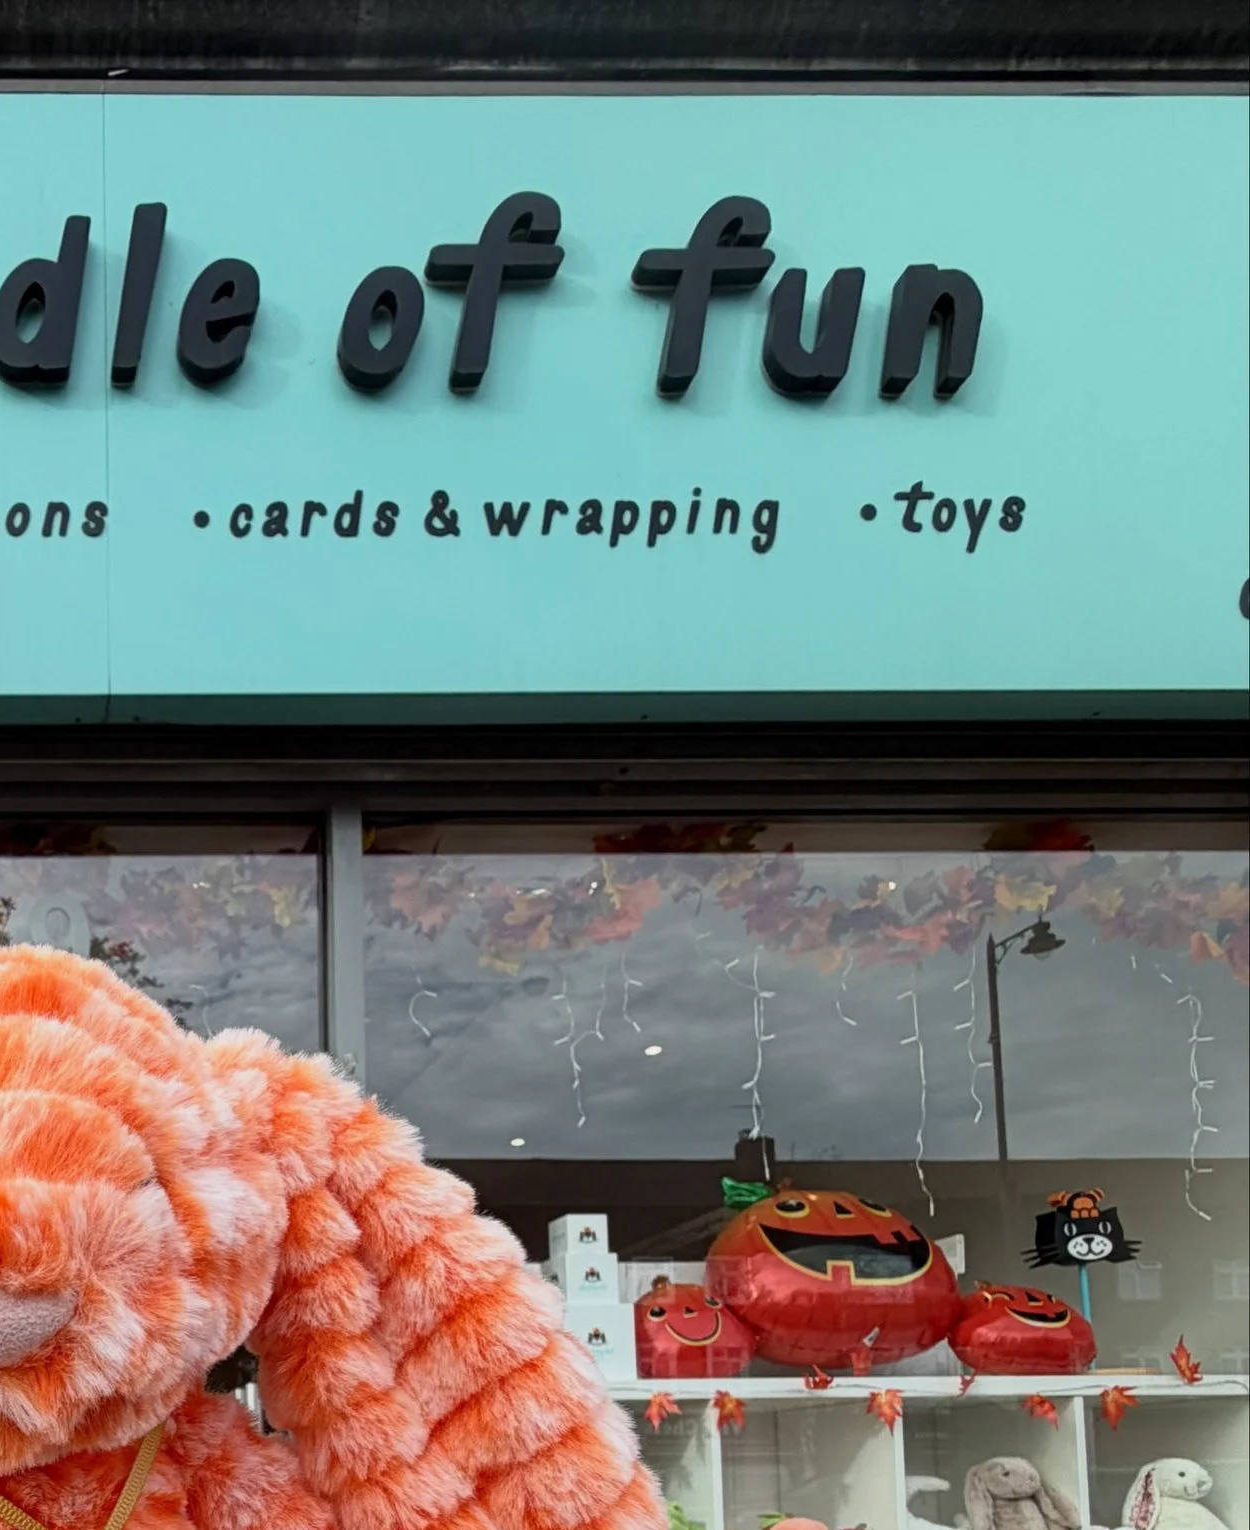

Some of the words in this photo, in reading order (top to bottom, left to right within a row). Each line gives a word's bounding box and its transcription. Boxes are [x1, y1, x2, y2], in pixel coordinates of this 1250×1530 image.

[336, 191, 565, 400] of
[630, 196, 983, 406] fun
[229, 489, 400, 538] cards
[424, 489, 461, 538] &
[483, 487, 780, 555] wrapping
[893, 480, 1026, 554] toys
